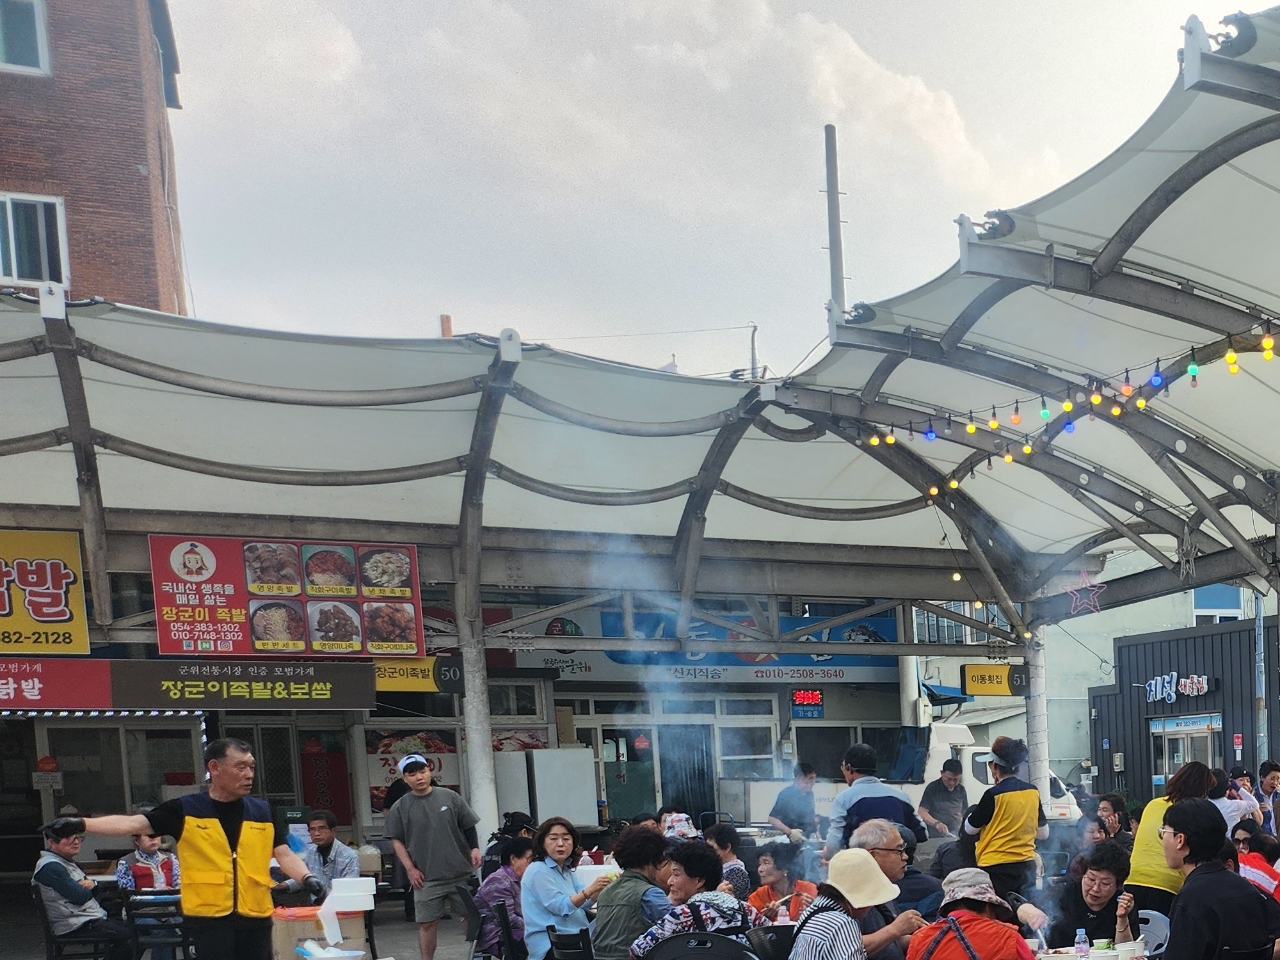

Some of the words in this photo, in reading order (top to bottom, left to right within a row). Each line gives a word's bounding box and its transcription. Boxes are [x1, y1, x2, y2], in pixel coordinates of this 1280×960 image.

[0, 558, 76, 622] 발
[162, 582, 197, 594] 국내산
[201, 583, 235, 595] 생족을
[176, 594, 200, 605] 매일
[204, 595, 227, 606] 삶는
[162, 606, 210, 621] 장군이
[216, 608, 247, 623] 족발
[170, 622, 240, 632] 054-383-1302
[171, 631, 243, 640] 010-7148-1302
[178, 665, 243, 676] 군위전통시장
[248, 666, 269, 676] 인증
[273, 667, 315, 676] 모범가게
[375, 667, 431, 679] 장군이족발
[441, 667, 460, 681] 50
[765, 668, 845, 679] 010-2508-3640
[971, 674, 1003, 685] 이동횟집
[1014, 674, 1026, 686] 51
[161, 681, 333, 699] 장군이족발&보쌈
[1146, 672, 1176, 703] 지성
